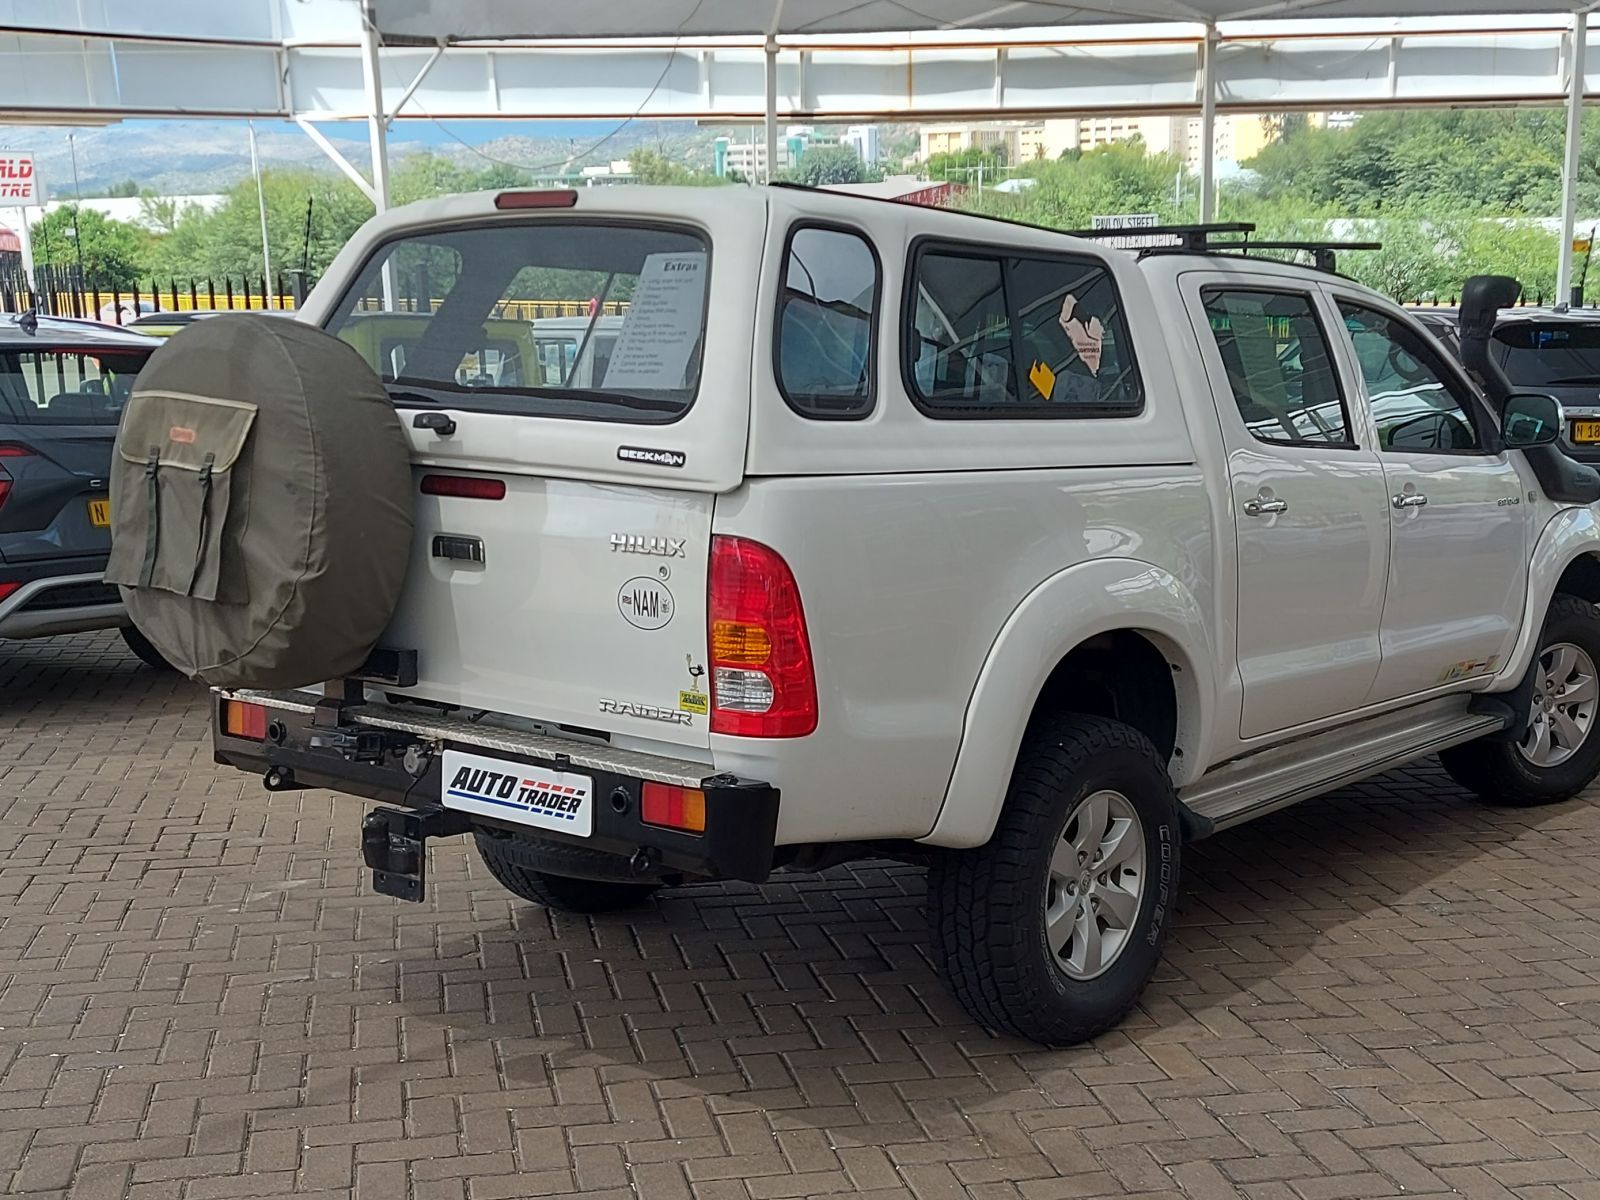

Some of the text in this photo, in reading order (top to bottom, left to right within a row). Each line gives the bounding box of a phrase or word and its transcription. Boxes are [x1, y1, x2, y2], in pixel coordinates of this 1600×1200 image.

[1, 183, 32, 197] TRE
[1128, 216, 1154, 228] STREET
[664, 262, 697, 271] Extras
[1576, 425, 1583, 438] N
[619, 448, 684, 465] BEEKMAN
[94, 503, 105, 522] N
[610, 533, 686, 558] HILUX
[633, 589, 659, 618] NAM
[600, 698, 693, 726] RAIDER
[450, 766, 583, 814] AUTO TRADER
[1147, 825, 1171, 946] COOPER
